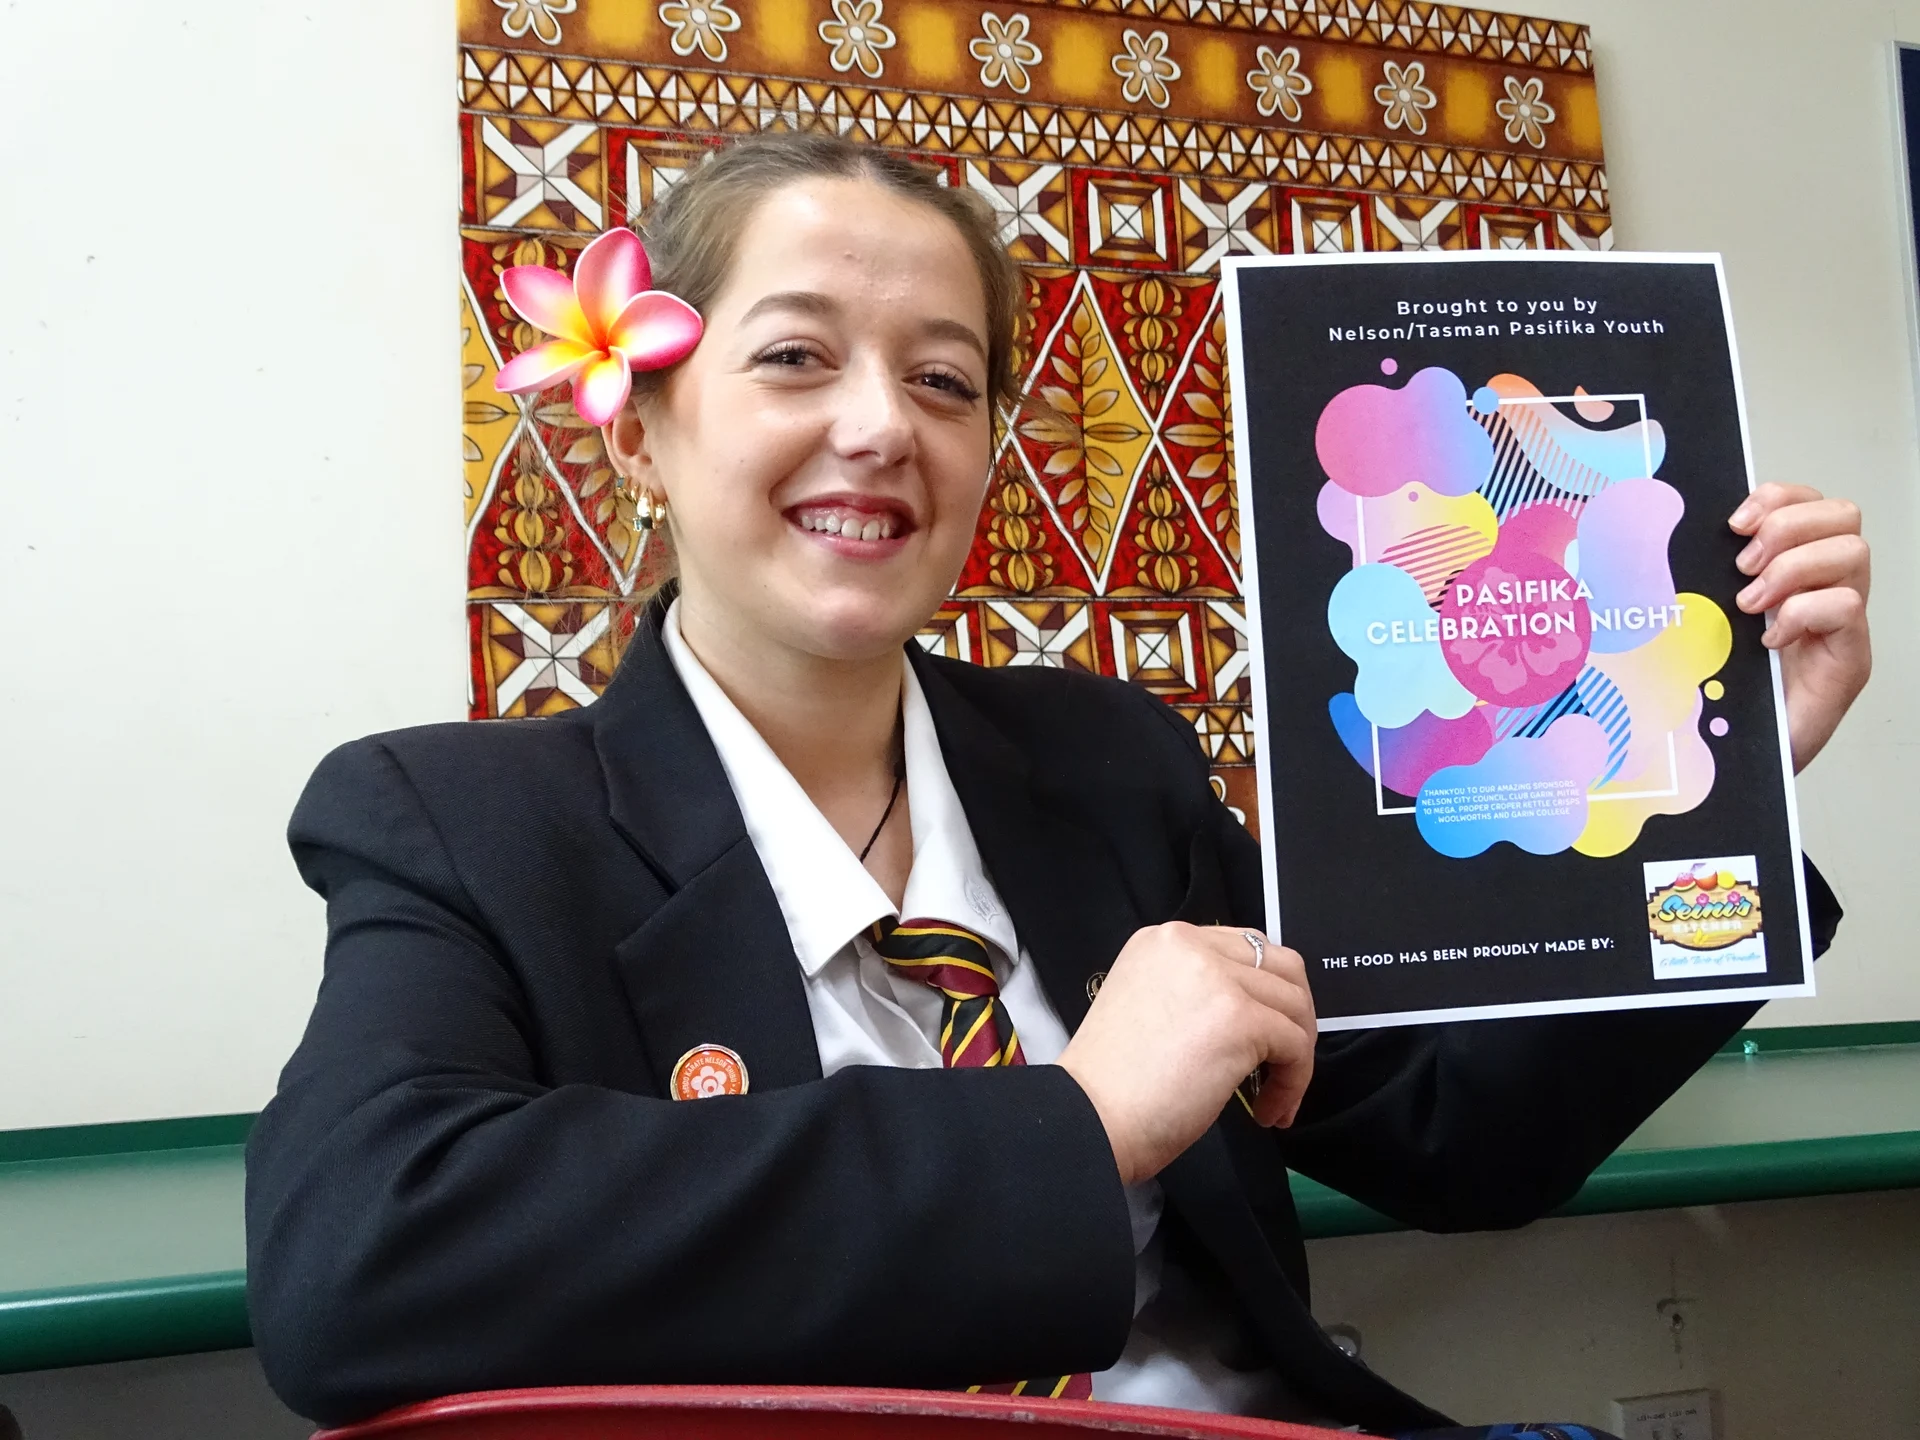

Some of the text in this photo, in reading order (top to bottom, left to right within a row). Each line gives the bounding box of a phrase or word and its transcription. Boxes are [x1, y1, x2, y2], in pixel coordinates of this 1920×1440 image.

[1397, 297, 1598, 317] Brought to you by
[1328, 319, 1665, 342] Nelson/Tasman Pasifika Youth
[1456, 578, 1595, 607] PASIFIKA
[1366, 604, 1686, 645] CELEBRATION NIGHT
[1421, 797, 1452, 806] NELSON
[1453, 796, 1471, 804] CITY
[1508, 792, 1529, 800] CLUB
[1556, 788, 1580, 797] MITRE
[1424, 787, 1466, 797] THANKYOU
[1467, 786, 1478, 794] TO
[1479, 785, 1496, 793] OUR
[1497, 782, 1531, 792] AMAZING
[1423, 807, 1432, 815] 10
[1458, 804, 1489, 813] PROPER
[1522, 799, 1551, 809] KETTLE
[1552, 797, 1581, 807] CRISPS
[1437, 807, 1571, 823] WOOLWORTHS AND GARIN COLLEGE
[1657, 892, 1753, 923] Seini's
[1322, 937, 1615, 969] THE FOOD HAS BEEN PROUDLY MADE BY:
[684, 1058, 705, 1077] KARATE
[705, 1056, 728, 1069] NELSON
